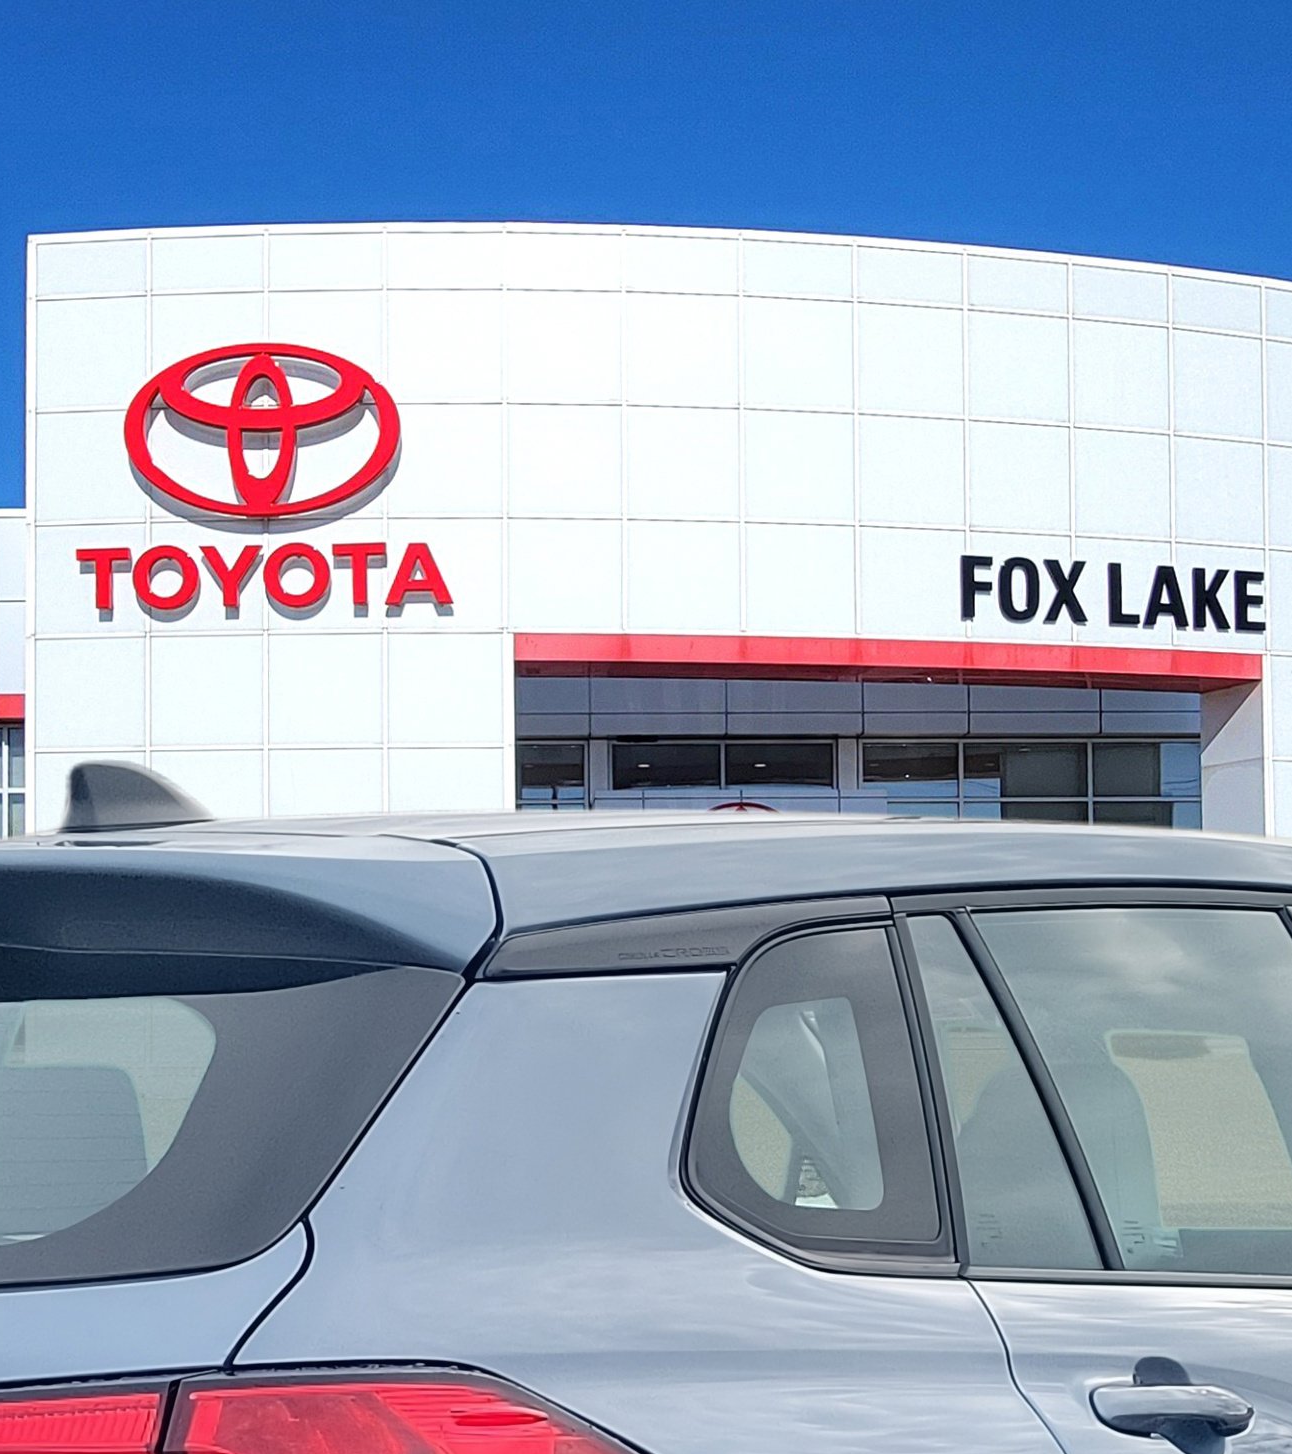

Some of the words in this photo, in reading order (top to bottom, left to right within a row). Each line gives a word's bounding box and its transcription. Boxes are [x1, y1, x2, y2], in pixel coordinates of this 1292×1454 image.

[75, 542, 455, 612] TOYOTA
[959, 555, 1088, 625] FOX
[1106, 562, 1267, 632] LAKE
